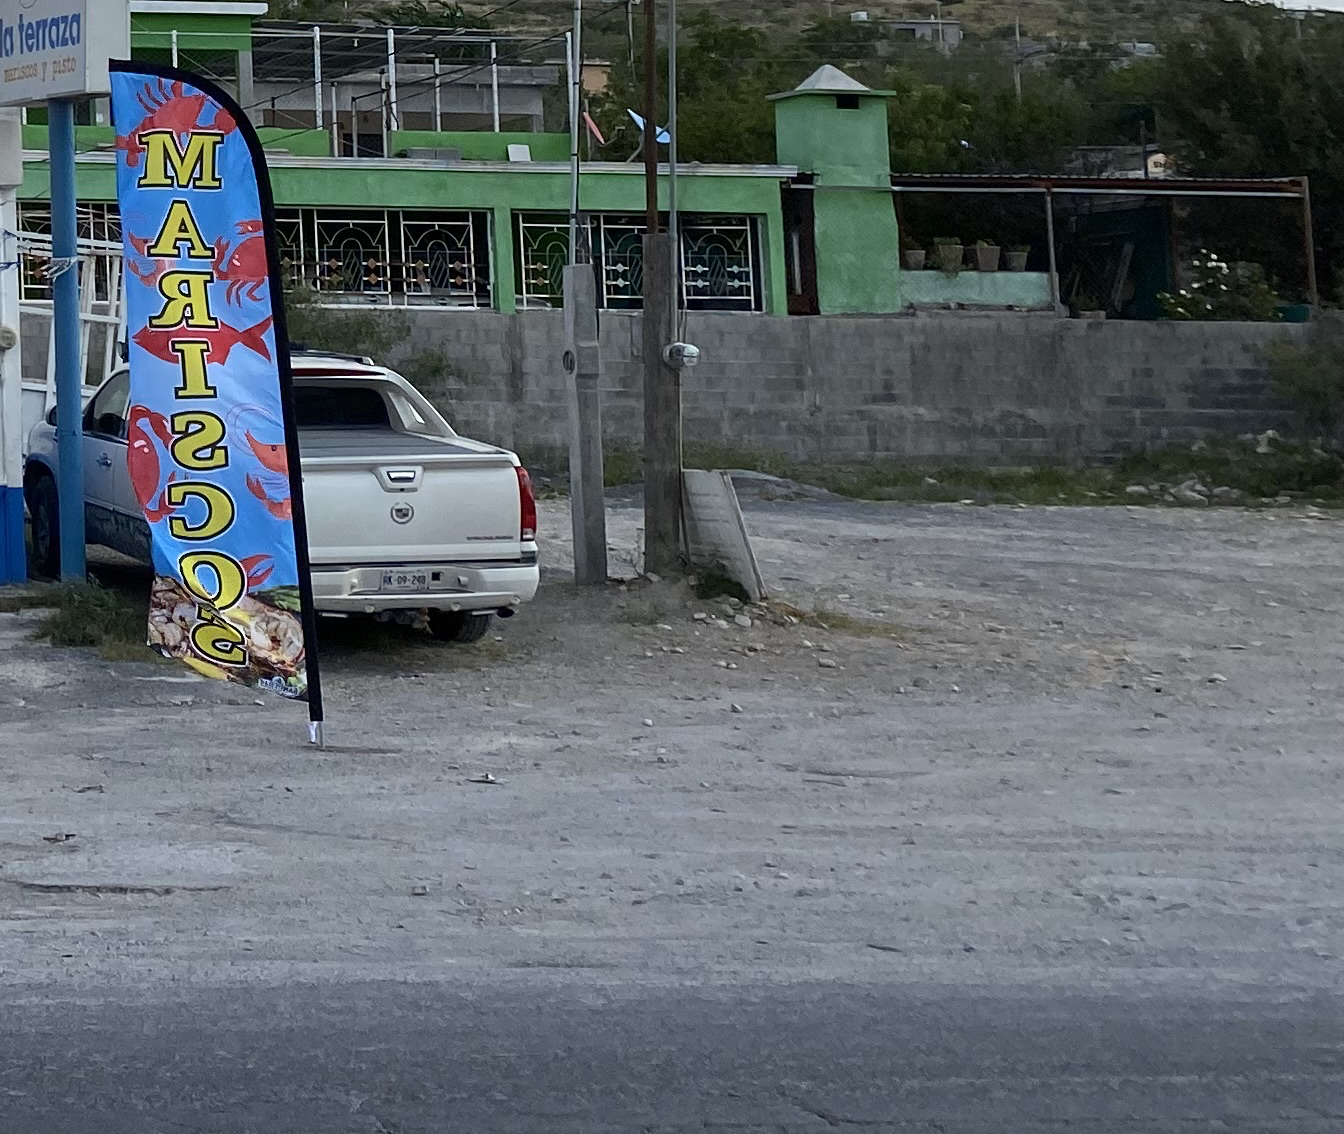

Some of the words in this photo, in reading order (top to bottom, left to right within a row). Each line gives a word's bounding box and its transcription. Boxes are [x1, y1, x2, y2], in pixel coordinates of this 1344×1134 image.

[0, 18, 14, 58] la
[18, 13, 81, 54] terraza
[52, 56, 77, 81] pisto
